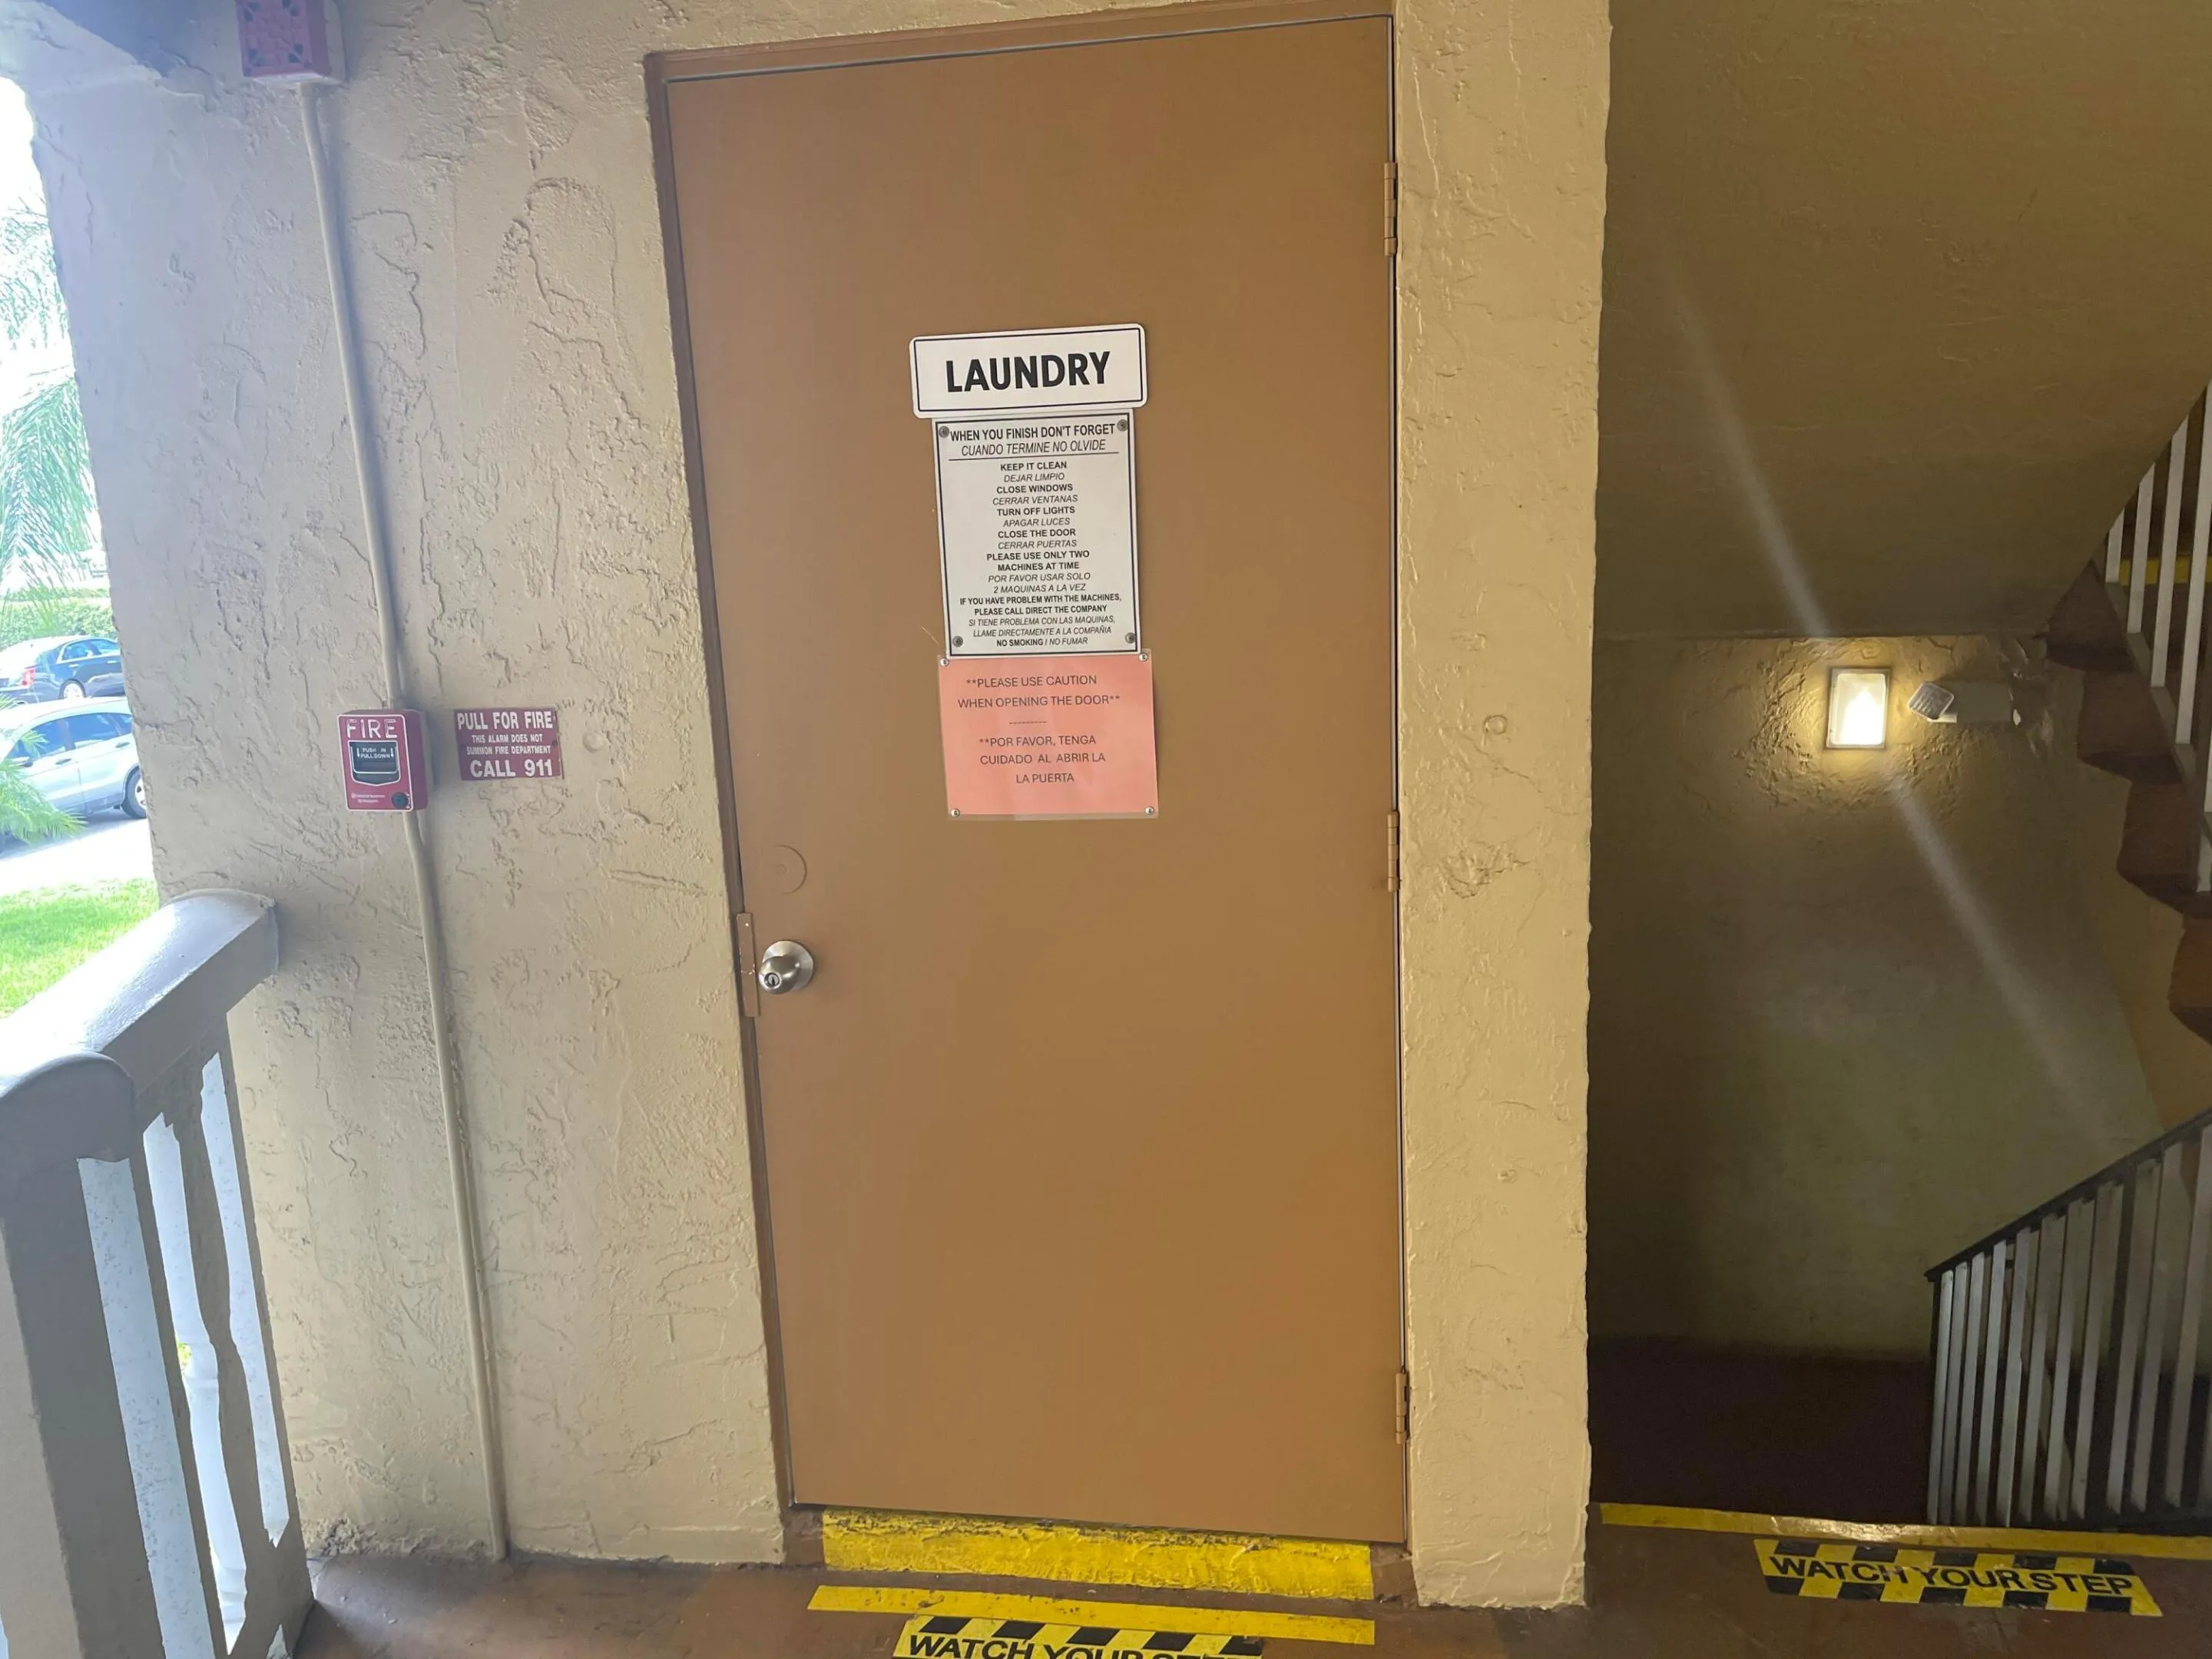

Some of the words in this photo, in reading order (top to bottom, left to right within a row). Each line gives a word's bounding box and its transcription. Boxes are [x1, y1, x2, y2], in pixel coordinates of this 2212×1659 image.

[946, 351, 1111, 392] LAUNDRY
[950, 430, 979, 442] WHEN
[982, 429, 1002, 440] YOU
[1006, 428, 1038, 439] FINISH
[1041, 426, 1071, 437] DON'T
[1075, 424, 1115, 435] FORGET
[962, 444, 1003, 456] CUANDO
[1007, 442, 1050, 454] TERMINE
[1052, 442, 1067, 452] NO
[1070, 439, 1106, 451] OLVIDE
[1035, 472, 1065, 481] LIMPIO
[997, 485, 1026, 494] CLOSE
[1028, 484, 1073, 492] WINDOWS
[992, 497, 1029, 505] CERRAR
[1031, 495, 1078, 504] VENTANAS
[1024, 507, 1041, 515] OFF
[1043, 506, 1075, 515] LIGHTS
[1003, 519, 1039, 528] APAGAR
[1041, 518, 1070, 526] LUCES
[998, 541, 1035, 550] CERRAR
[1037, 539, 1077, 548] PUERTAS
[1023, 551, 1041, 560] USE
[1069, 550, 1090, 558] TWO
[998, 563, 1044, 571] MACHINES
[1058, 561, 1079, 570] TIME
[1081, 594, 1121, 602] MACHINES,
[998, 628, 1055, 637] DIRECTAMENTE
[1022, 677, 1043, 686] USE
[1046, 675, 1097, 685] CAUTION
[958, 698, 992, 708] WHEN
[995, 696, 1048, 707] OPENING
[1051, 696, 1072, 705] THE
[457, 713, 488, 730] PULL
[493, 712, 519, 729] FOR
[524, 711, 553, 729] FIRE
[346, 719, 397, 738] FIRE
[488, 734, 508, 743] ALARM
[530, 733, 543, 742] NOT
[1017, 736, 1055, 747] FAVOR,
[1058, 736, 1096, 745] TENGA
[467, 747, 493, 755] SUMMON
[511, 745, 551, 754] DEPARTMENT
[980, 754, 1032, 765] CUIDADO
[1038, 754, 1051, 763] AL
[1057, 753, 1089, 763] ABRIR
[1092, 753, 1106, 762] LA
[470, 760, 516, 777] CALL
[524, 759, 553, 777] 911
[1015, 774, 1029, 783] LA
[1032, 773, 1075, 783] PUERTA
[1770, 1555, 1908, 1584] WATCH
[1912, 1566, 2026, 1590] YOUR
[2028, 1573, 2133, 1595] STEP
[909, 1635, 1035, 1659] WATCH
